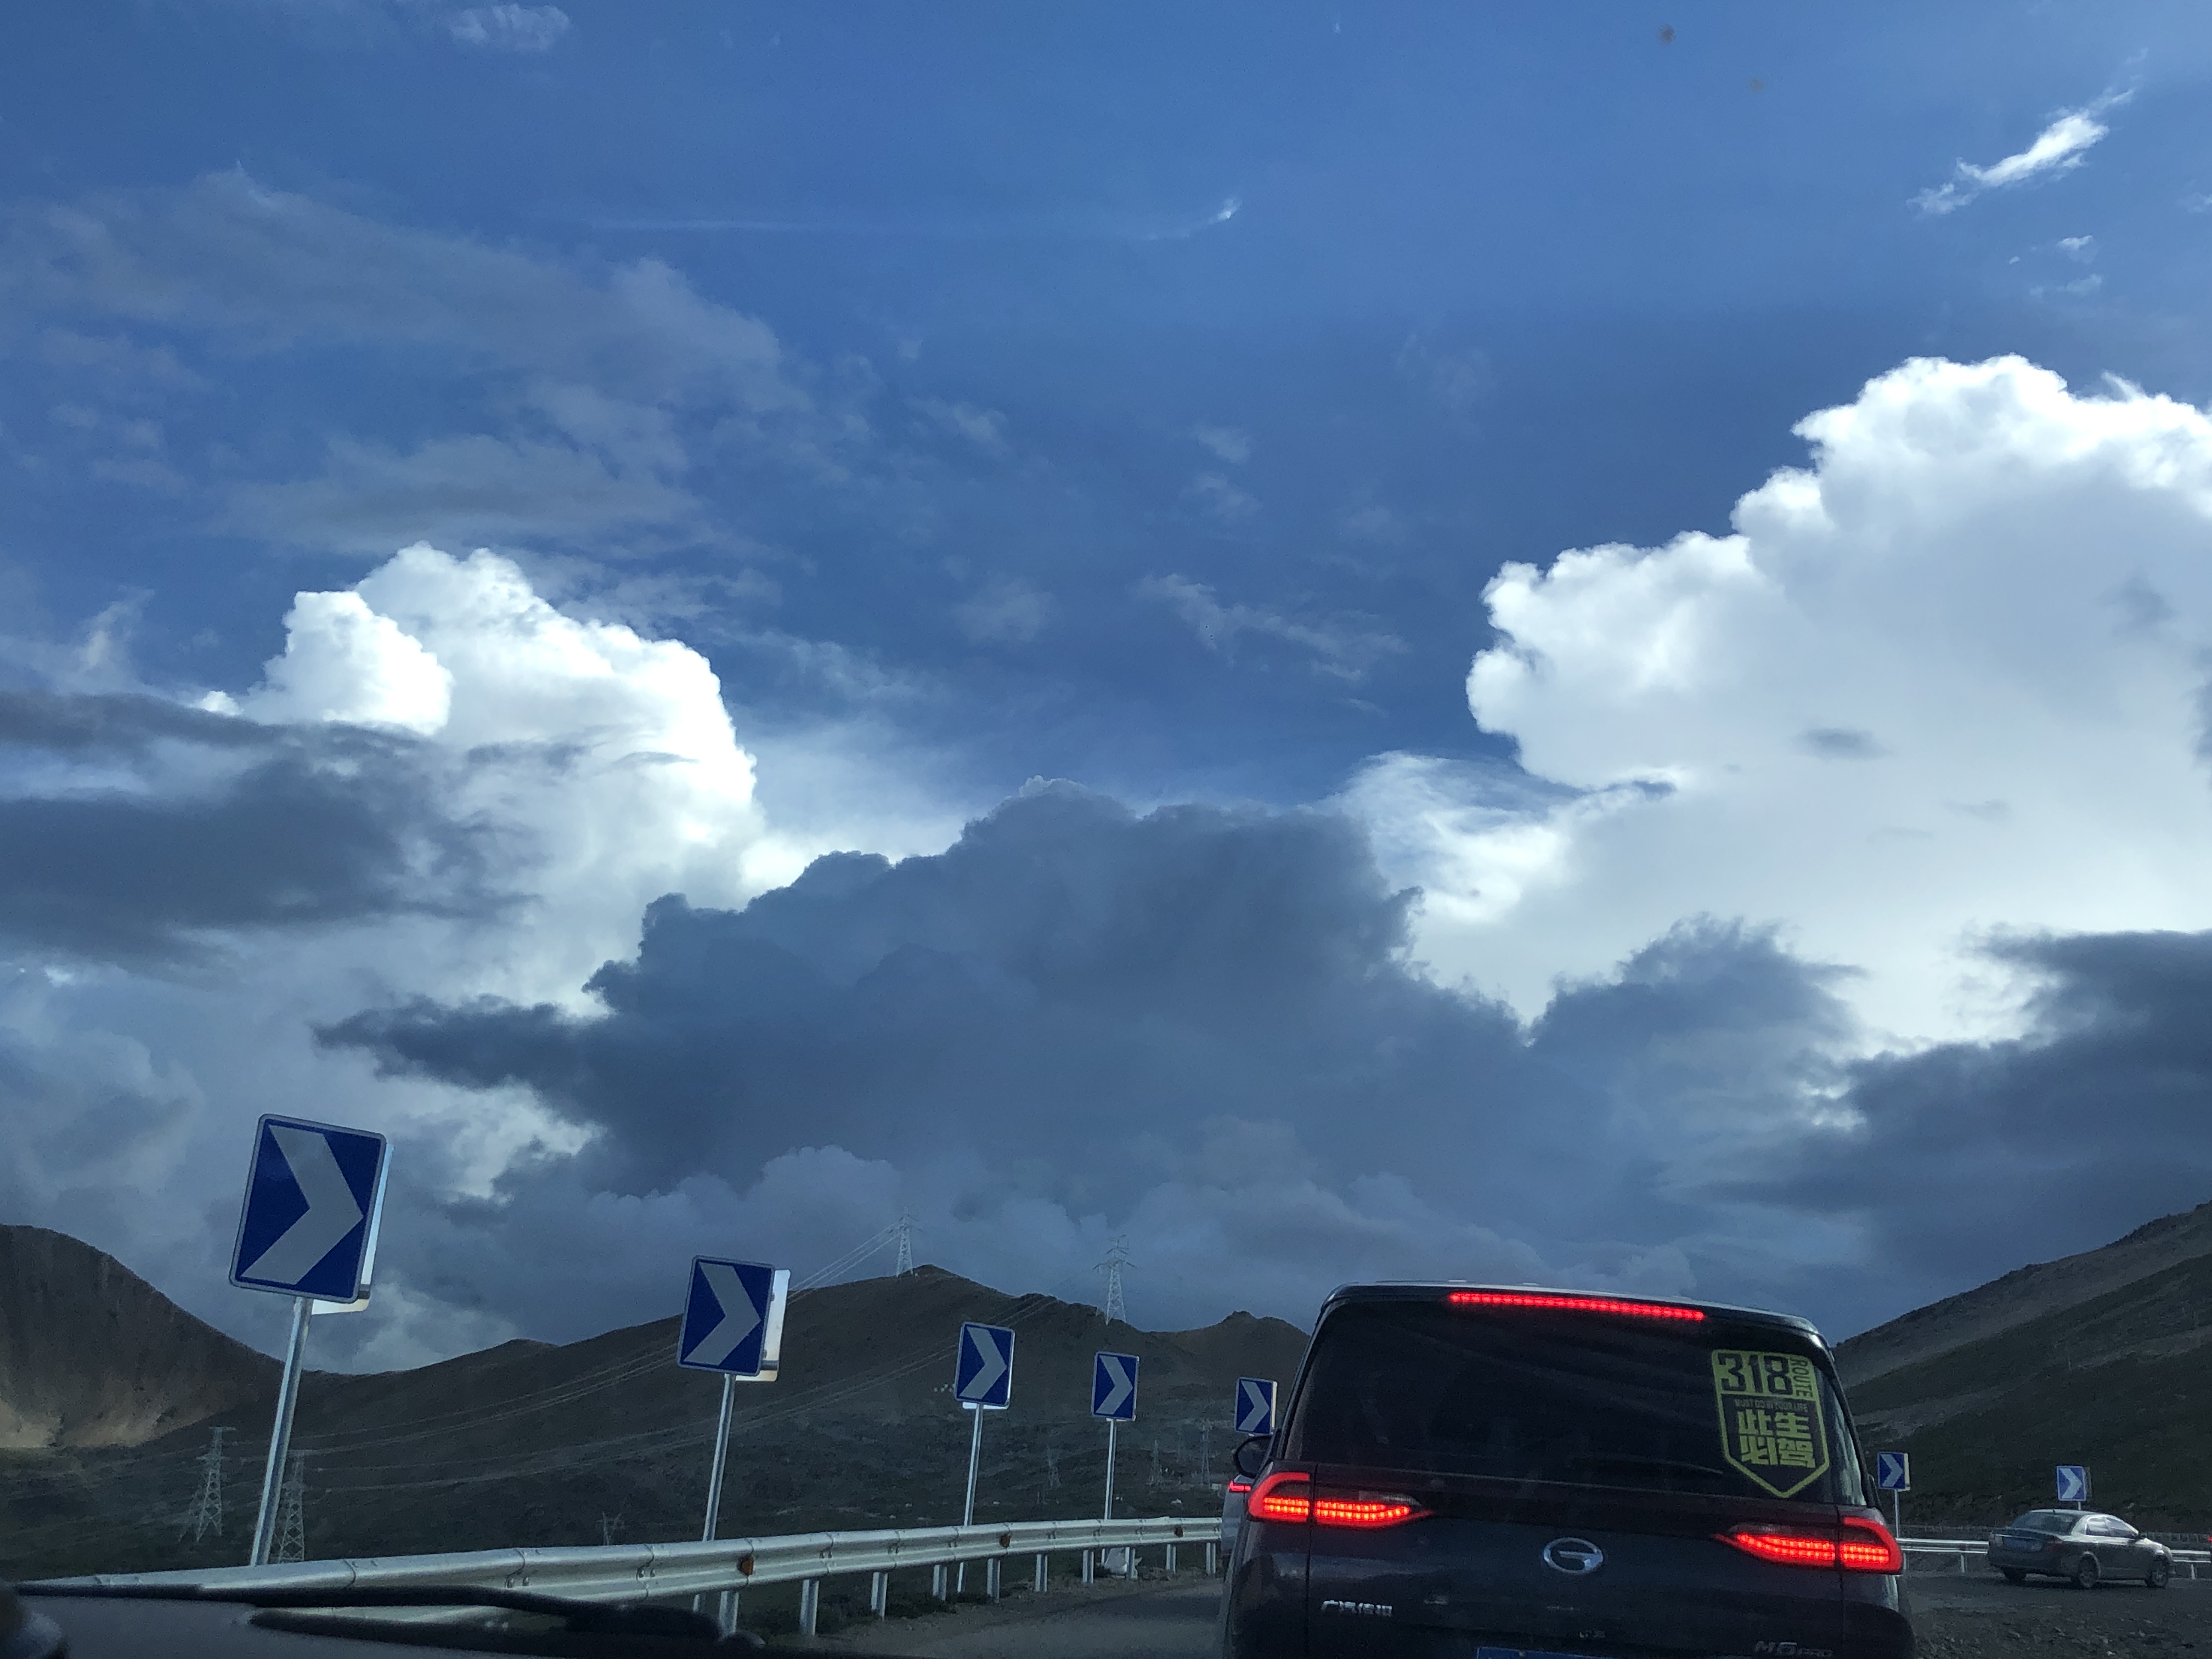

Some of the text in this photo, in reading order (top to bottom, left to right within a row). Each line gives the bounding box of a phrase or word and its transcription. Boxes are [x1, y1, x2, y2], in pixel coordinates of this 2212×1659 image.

[1717, 1353, 1793, 1395] 318
[1789, 1356, 1813, 1397] ROUTE
[1735, 1399, 1753, 1407] MUST
[1755, 1400, 1765, 1408] GO
[1774, 1401, 1792, 1411] YOUR
[1793, 1402, 1809, 1413] LIFE
[1737, 1409, 1811, 1440] 此生
